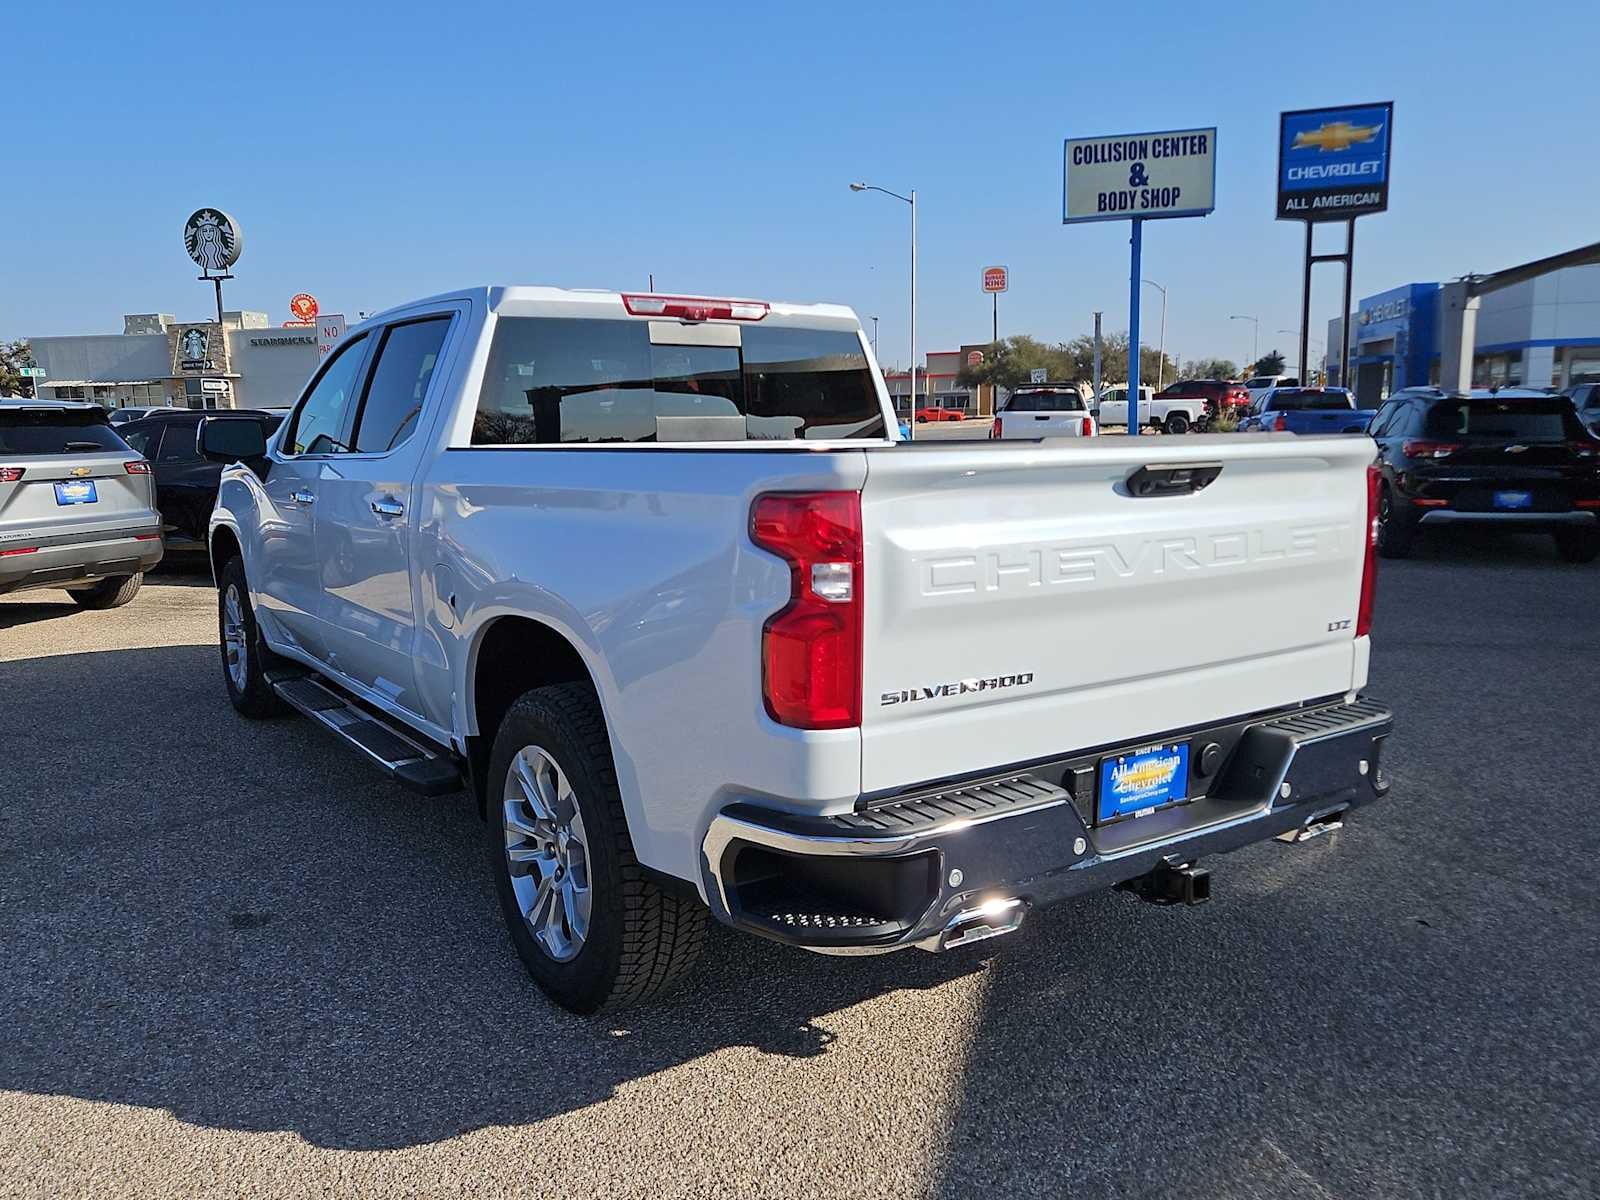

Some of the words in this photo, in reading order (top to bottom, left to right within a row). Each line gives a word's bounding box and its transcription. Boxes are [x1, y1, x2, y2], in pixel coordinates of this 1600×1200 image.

[1073, 140, 1148, 166] COLLISION
[1152, 134, 1208, 159] CENTER
[1129, 162, 1149, 187] &
[1287, 160, 1381, 181] CHEVROLET
[1097, 189, 1138, 213] BODY
[1140, 186, 1181, 210] SHOP
[1286, 198, 1309, 211] ALL
[1312, 192, 1380, 209] AMERICAN
[985, 279, 1006, 288] KING
[324, 326, 338, 338] NO
[922, 521, 1350, 596] CHEVROLET
[1327, 619, 1351, 632] LTZ
[881, 672, 1034, 707] SILVERADO
[1110, 763, 1128, 781] All
[1130, 755, 1181, 775] American
[1119, 775, 1173, 794] Chevrolet
